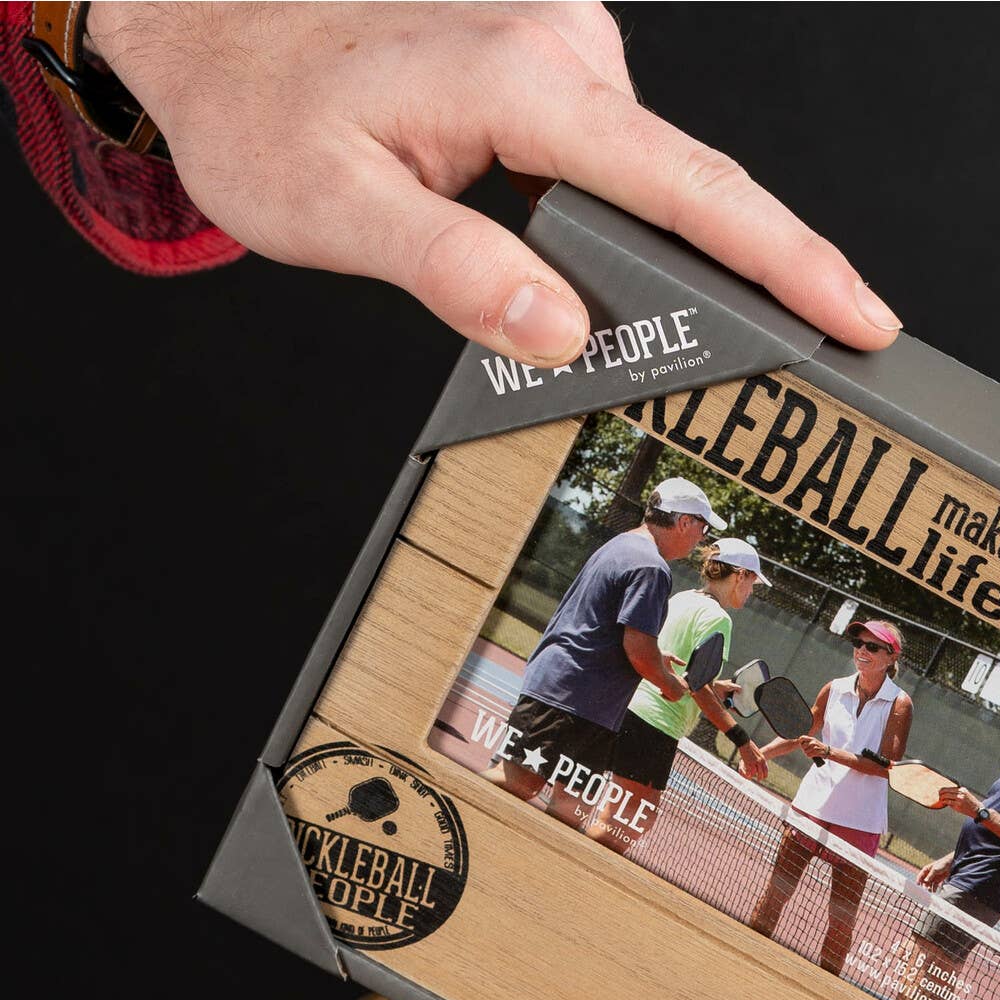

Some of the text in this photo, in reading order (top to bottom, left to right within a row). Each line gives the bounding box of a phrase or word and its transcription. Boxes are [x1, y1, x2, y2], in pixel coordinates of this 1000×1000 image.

[480, 356, 544, 396] WE
[628, 368, 646, 383] by
[470, 709, 523, 761] WE
[574, 806, 587, 821] by
[292, 819, 436, 909] ICKLEBALL
[310, 870, 419, 929] EOPLE
[882, 957, 891, 968] x
[893, 960, 917, 983] 15.2
[891, 941, 972, 994] 4 x 6 inches
